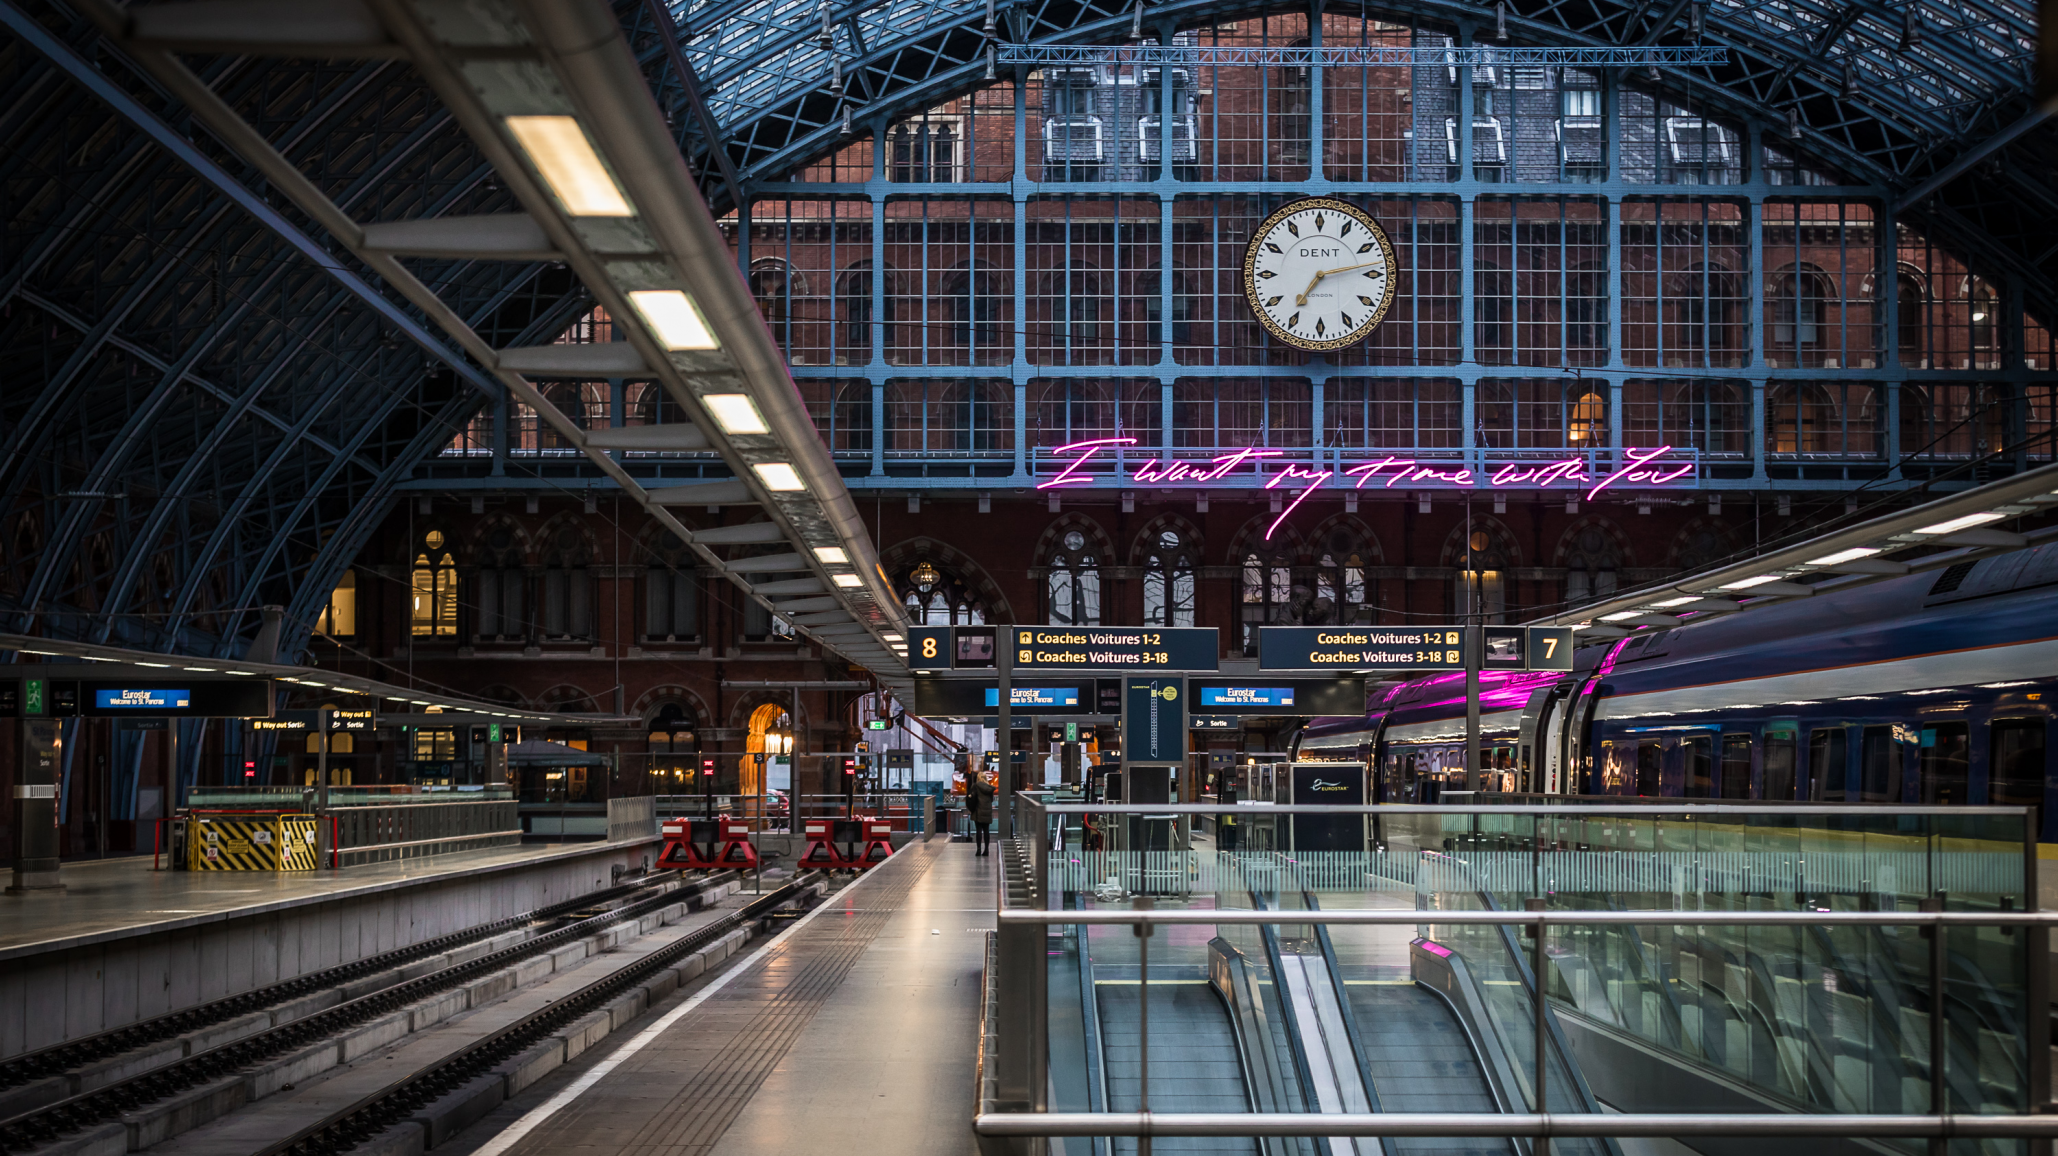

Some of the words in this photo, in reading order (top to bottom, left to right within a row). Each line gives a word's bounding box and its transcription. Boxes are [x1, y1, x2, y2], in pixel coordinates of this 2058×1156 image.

[1300, 248, 1340, 257] DENT
[1037, 438, 1137, 490] I
[1587, 445, 1693, 501] You
[1036, 632, 1087, 644] Coaches
[1089, 633, 1140, 645] Voitures
[1142, 634, 1161, 645] 1-2
[1317, 632, 1368, 644] Coaches
[1370, 633, 1421, 644] Voitures
[1423, 633, 1442, 644] 1-2
[922, 637, 938, 658] 8
[1543, 638, 1558, 659] 7
[1036, 650, 1087, 663] Coaches
[1089, 651, 1140, 663] Voitures
[1142, 652, 1169, 664] 3-18
[1309, 650, 1360, 662] Coaches
[1362, 651, 1414, 662] Voitures
[1416, 651, 1442, 662] 3-18
[122, 689, 151, 699] Eurostar
[1011, 688, 1040, 697] Eurostar
[1227, 688, 1256, 697] Eurostar
[341, 711, 353, 719] Way
[262, 722, 275, 730] Way
[287, 721, 305, 729] Sortie
[347, 721, 364, 729] Sortie
[756, 753, 763, 762] S
